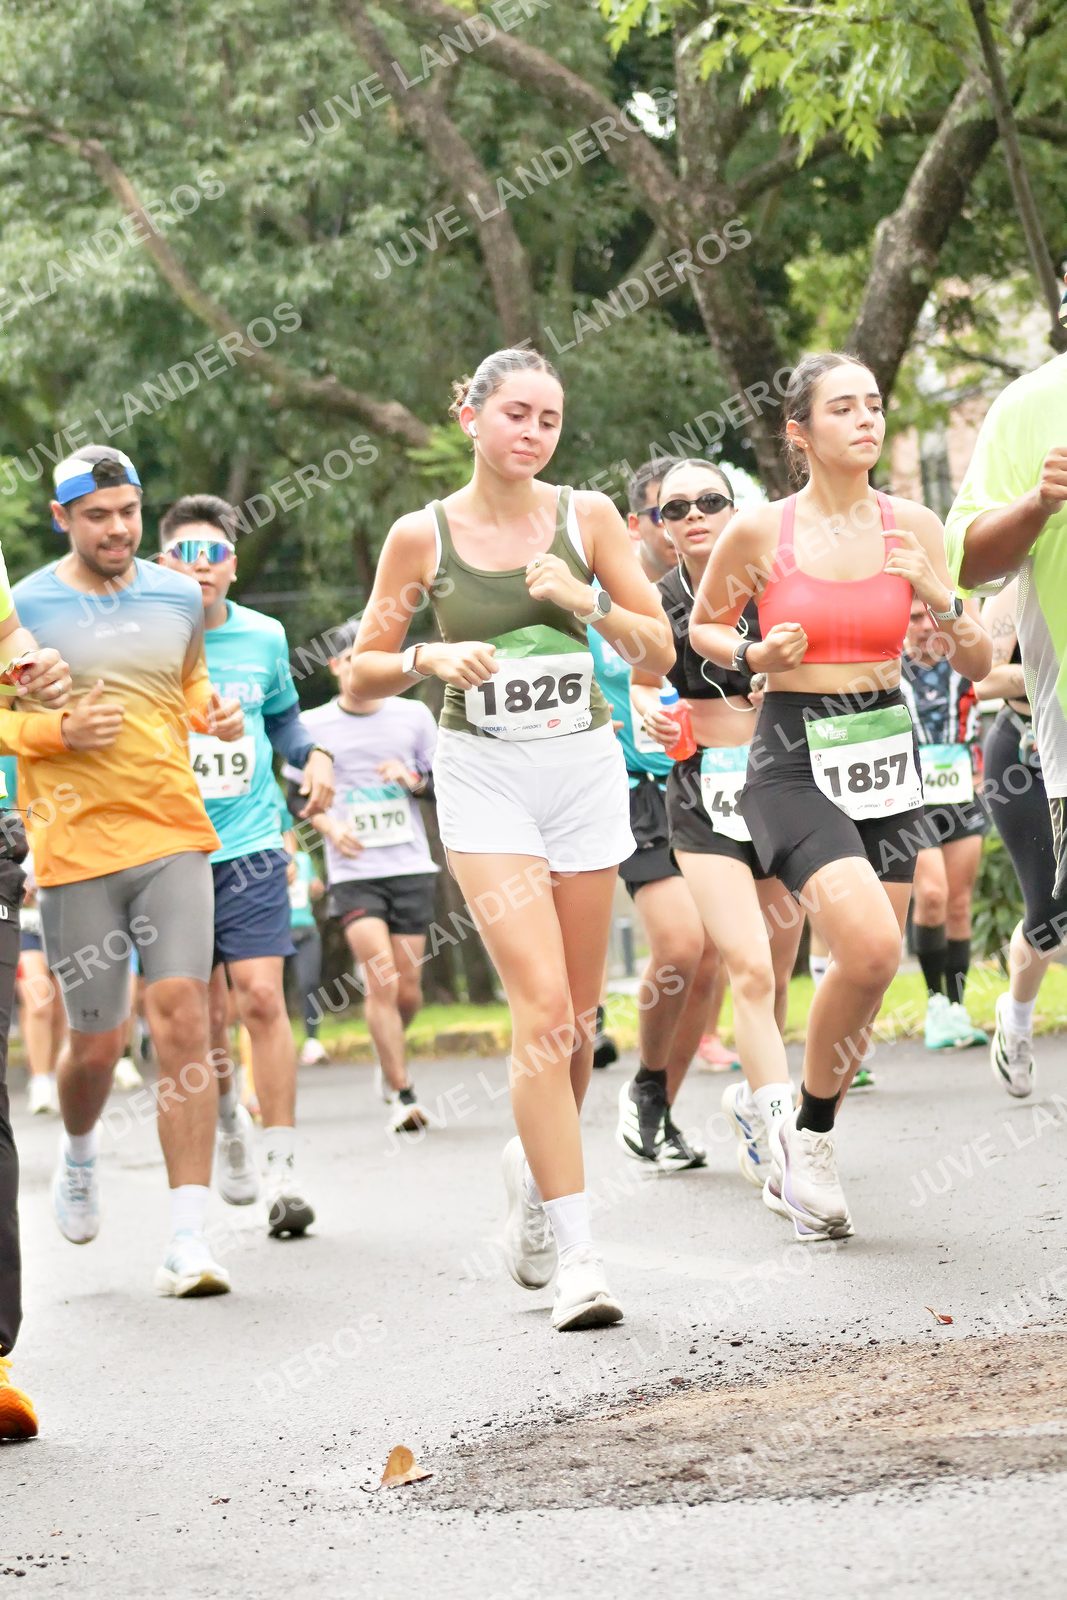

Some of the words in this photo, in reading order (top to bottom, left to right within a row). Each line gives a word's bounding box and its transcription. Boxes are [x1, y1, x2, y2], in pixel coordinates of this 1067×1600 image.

[477, 673, 584, 717] 1826
[192, 752, 248, 777] 419
[823, 751, 908, 798] 1857
[925, 771, 960, 788] 400
[354, 810, 405, 832] 5170
